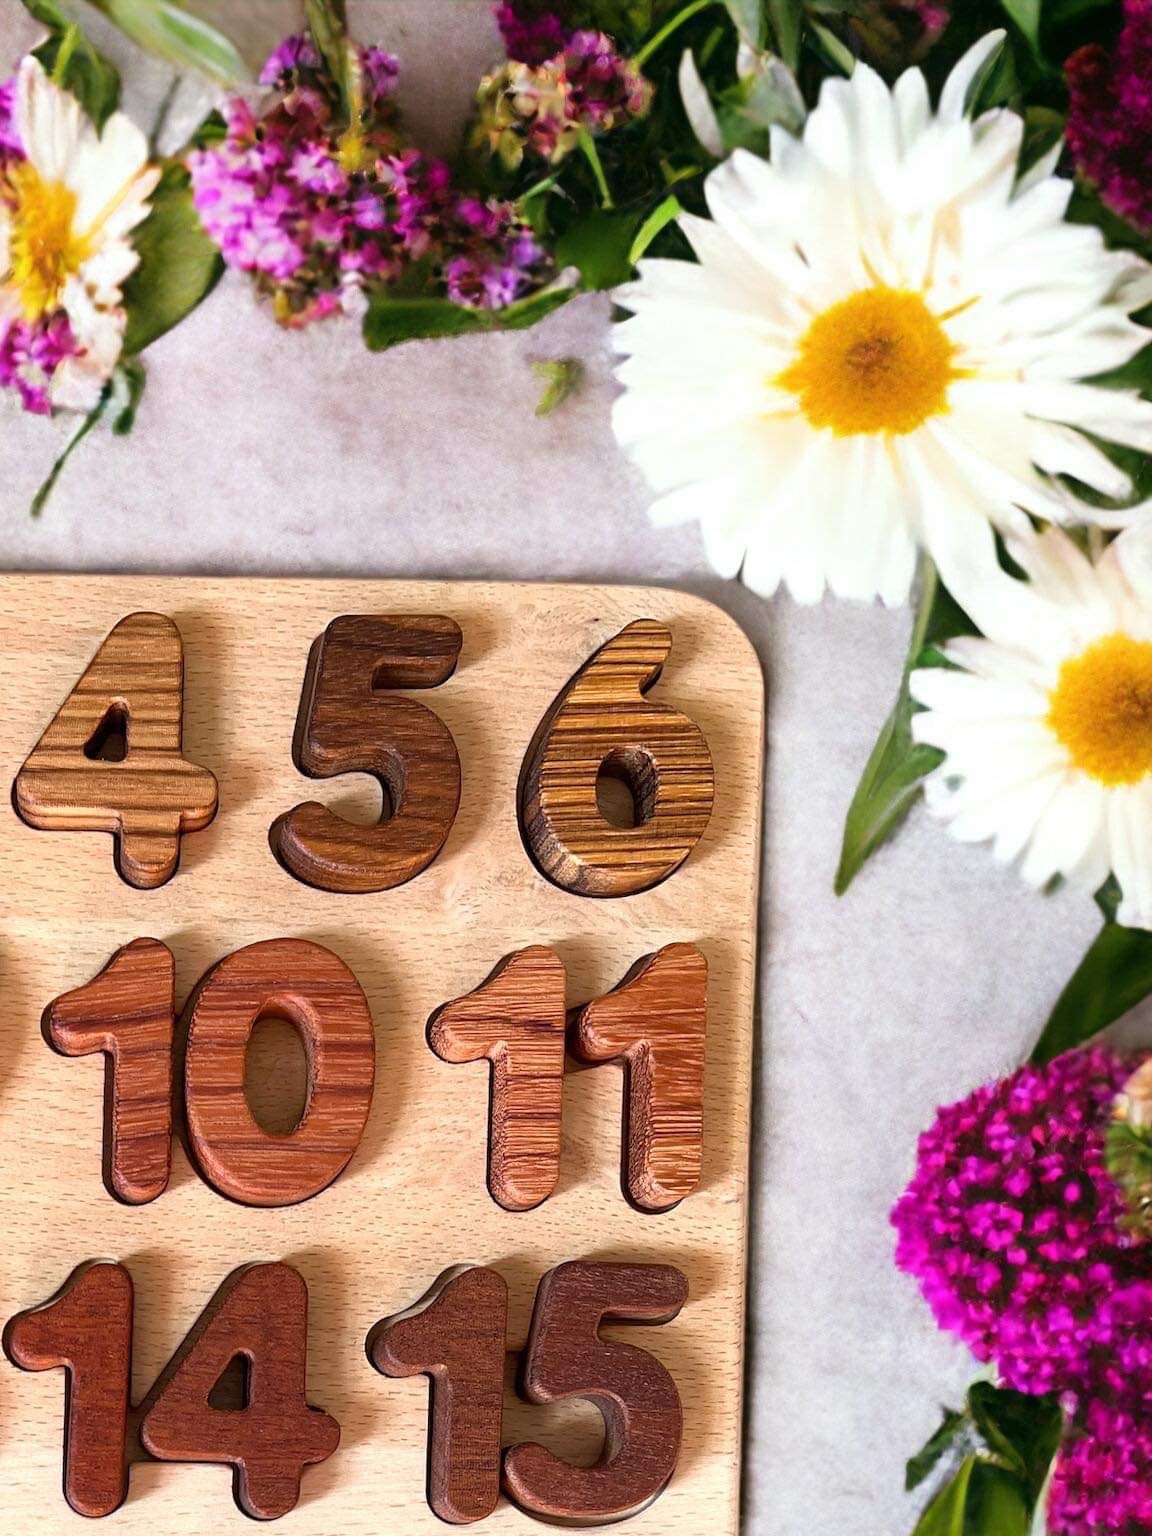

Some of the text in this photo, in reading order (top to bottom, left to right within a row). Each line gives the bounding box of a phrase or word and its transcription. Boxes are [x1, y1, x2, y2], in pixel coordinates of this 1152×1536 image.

[11, 611, 218, 890] 4
[268, 615, 462, 894] 5
[516, 618, 715, 899] 6
[41, 937, 376, 1208] 10
[425, 942, 708, 1214] 11
[1, 1258, 341, 1520] 14
[365, 1260, 689, 1528] 15
